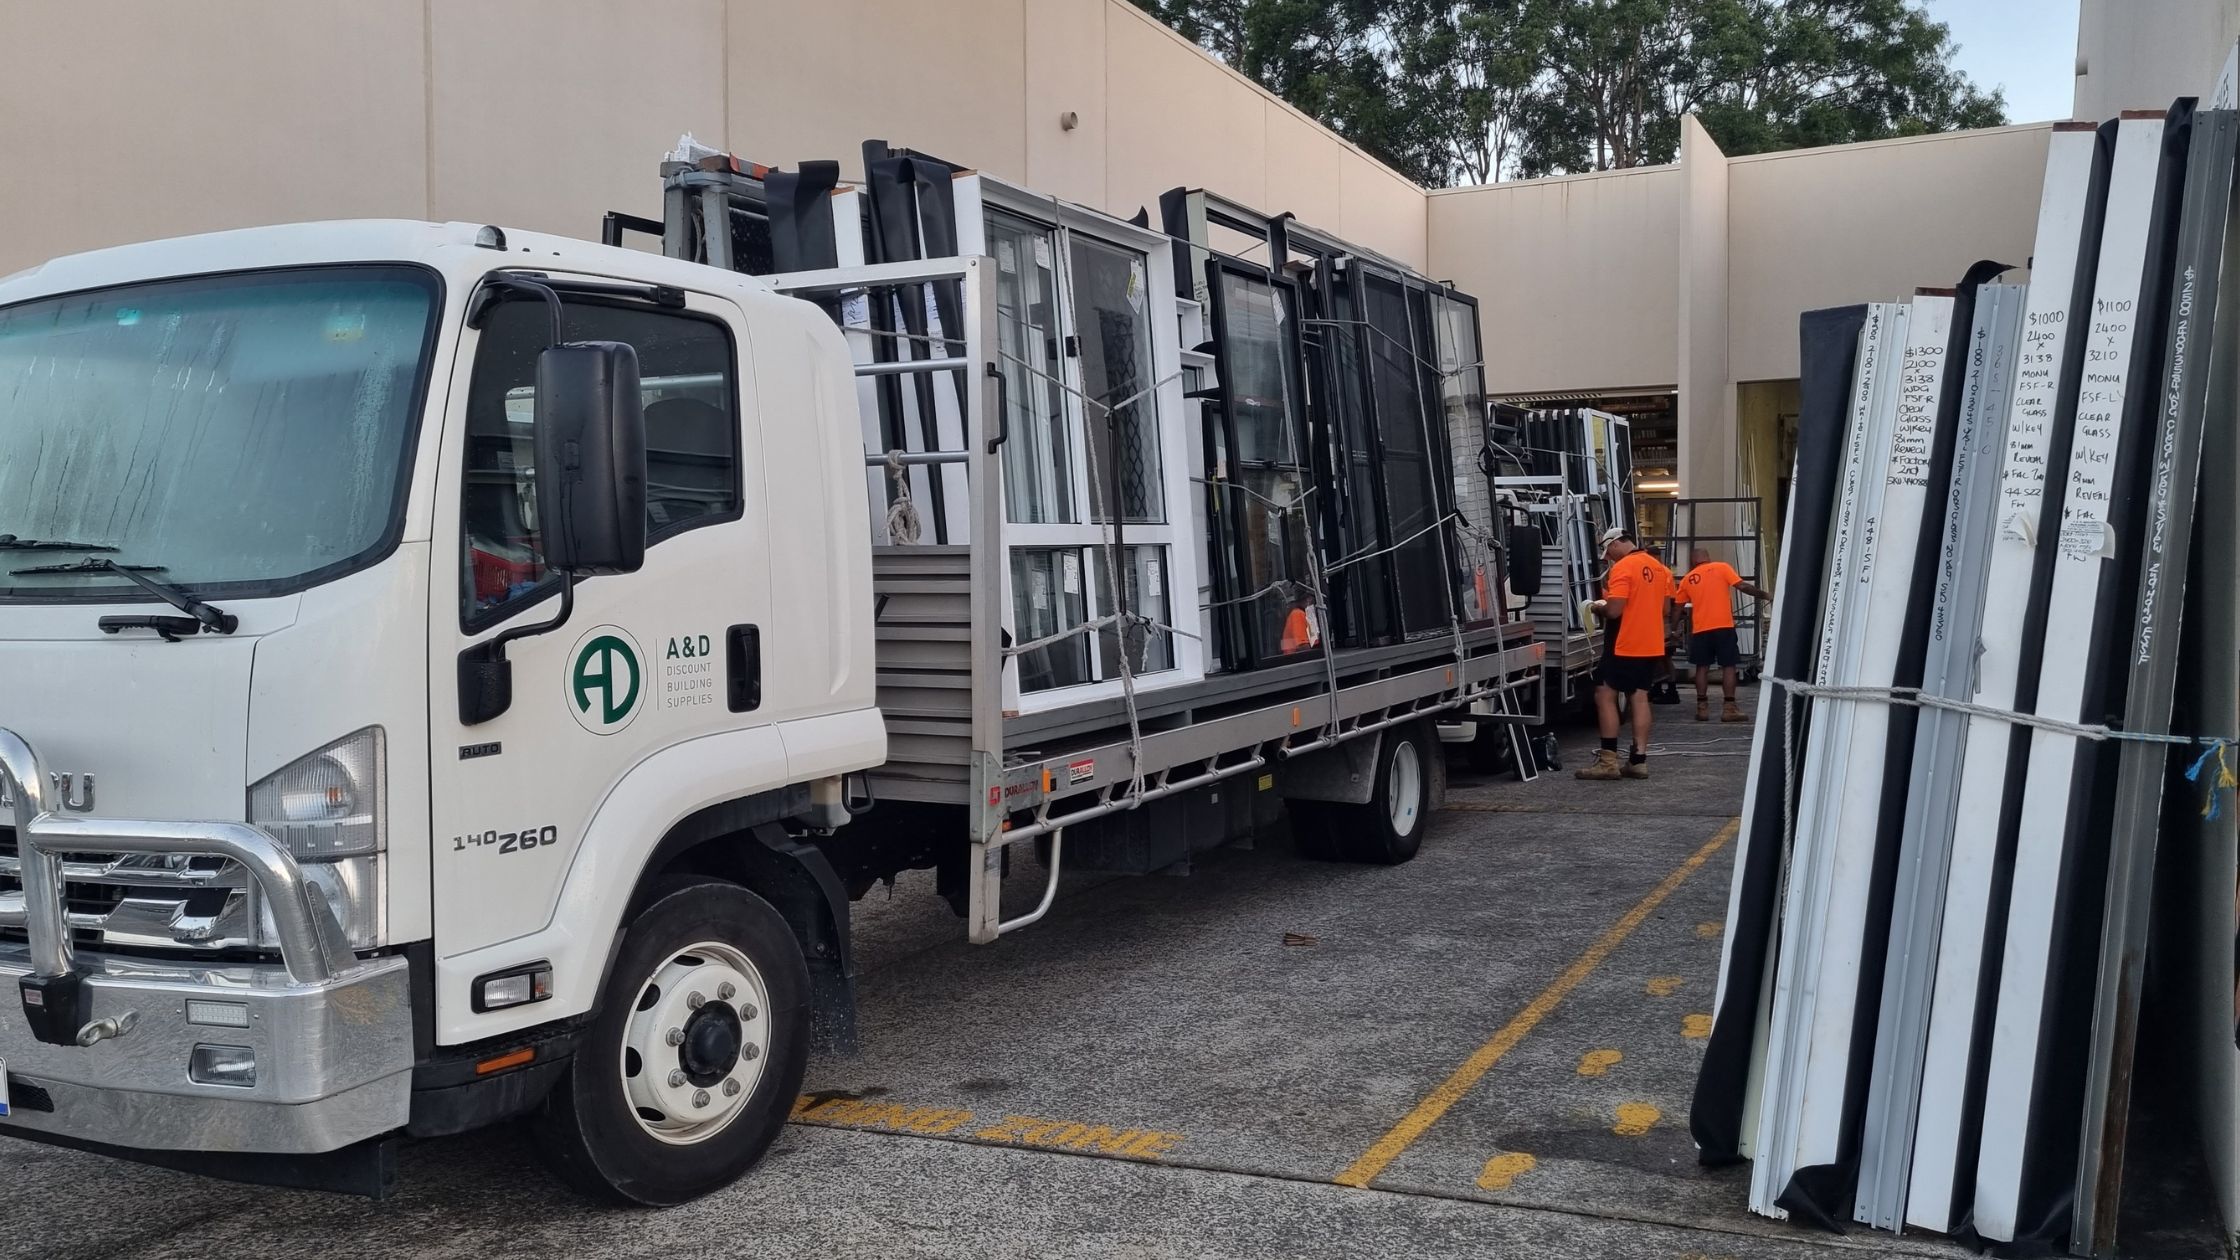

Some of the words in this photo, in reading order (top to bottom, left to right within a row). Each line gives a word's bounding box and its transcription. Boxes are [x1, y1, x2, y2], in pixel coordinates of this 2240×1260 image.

[2097, 298, 2132, 315] $1100
[2029, 310, 2065, 326] $1000
[2095, 323, 2127, 334] 2400
[2027, 330, 2055, 342] 2400
[1905, 346, 1944, 358] $1300
[2023, 353, 2053, 364] 3138
[2089, 349, 2118, 362] 3210
[1904, 360, 1937, 370] 2100
[1904, 375, 1934, 384] 3138
[1899, 414, 1932, 424] Glass
[1894, 444, 1926, 454] Reveal
[666, 635, 711, 660] A&D
[667, 662, 712, 676] DISCOUNT
[667, 678, 713, 693] BUILDING
[667, 694, 714, 708] SUPPLIES
[460, 743, 501, 759] AUTO
[498, 825, 558, 855] 260
[976, 1114, 1186, 1159] ZONE
